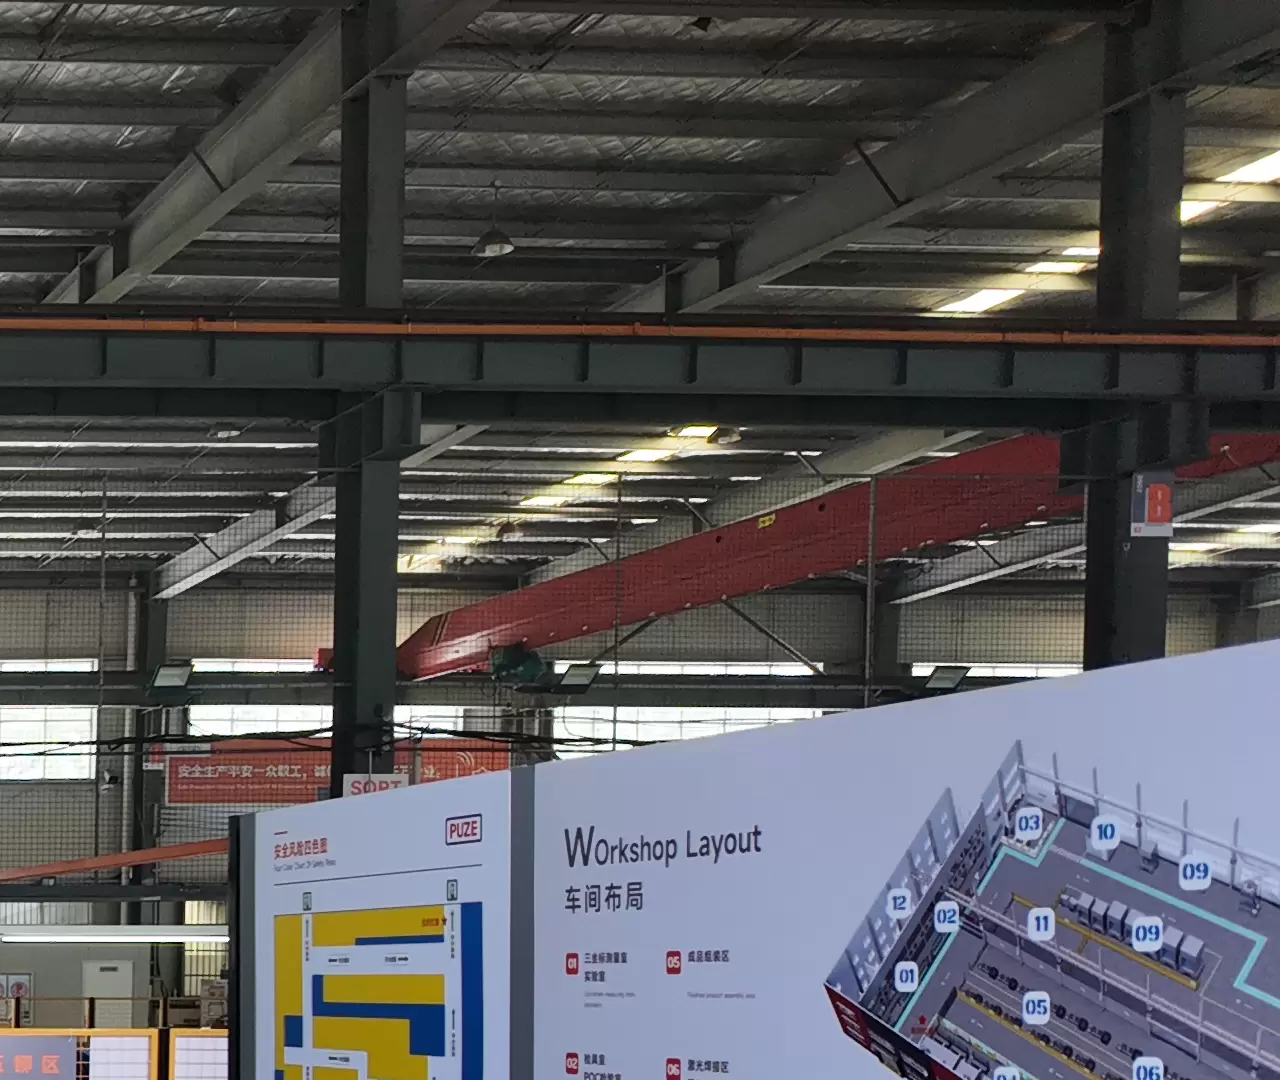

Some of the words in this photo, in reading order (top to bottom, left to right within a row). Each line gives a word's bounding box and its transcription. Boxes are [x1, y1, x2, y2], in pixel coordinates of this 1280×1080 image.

[449, 820, 478, 839] PUZE
[1018, 814, 1039, 832] 03
[1097, 823, 1116, 841] 10
[564, 825, 678, 868] Workshop
[686, 824, 762, 864] Layout
[1182, 862, 1209, 881] 09
[564, 881, 644, 914] 车间布局
[892, 895, 907, 911] 12
[937, 908, 956, 924] 02
[1035, 915, 1049, 932] 11
[1134, 924, 1161, 942] 09
[568, 957, 577, 969] 01
[667, 955, 680, 969] 05
[899, 968, 915, 984] 01
[1025, 999, 1048, 1015] 05
[566, 1057, 578, 1070] 02
[667, 1063, 680, 1076] 06
